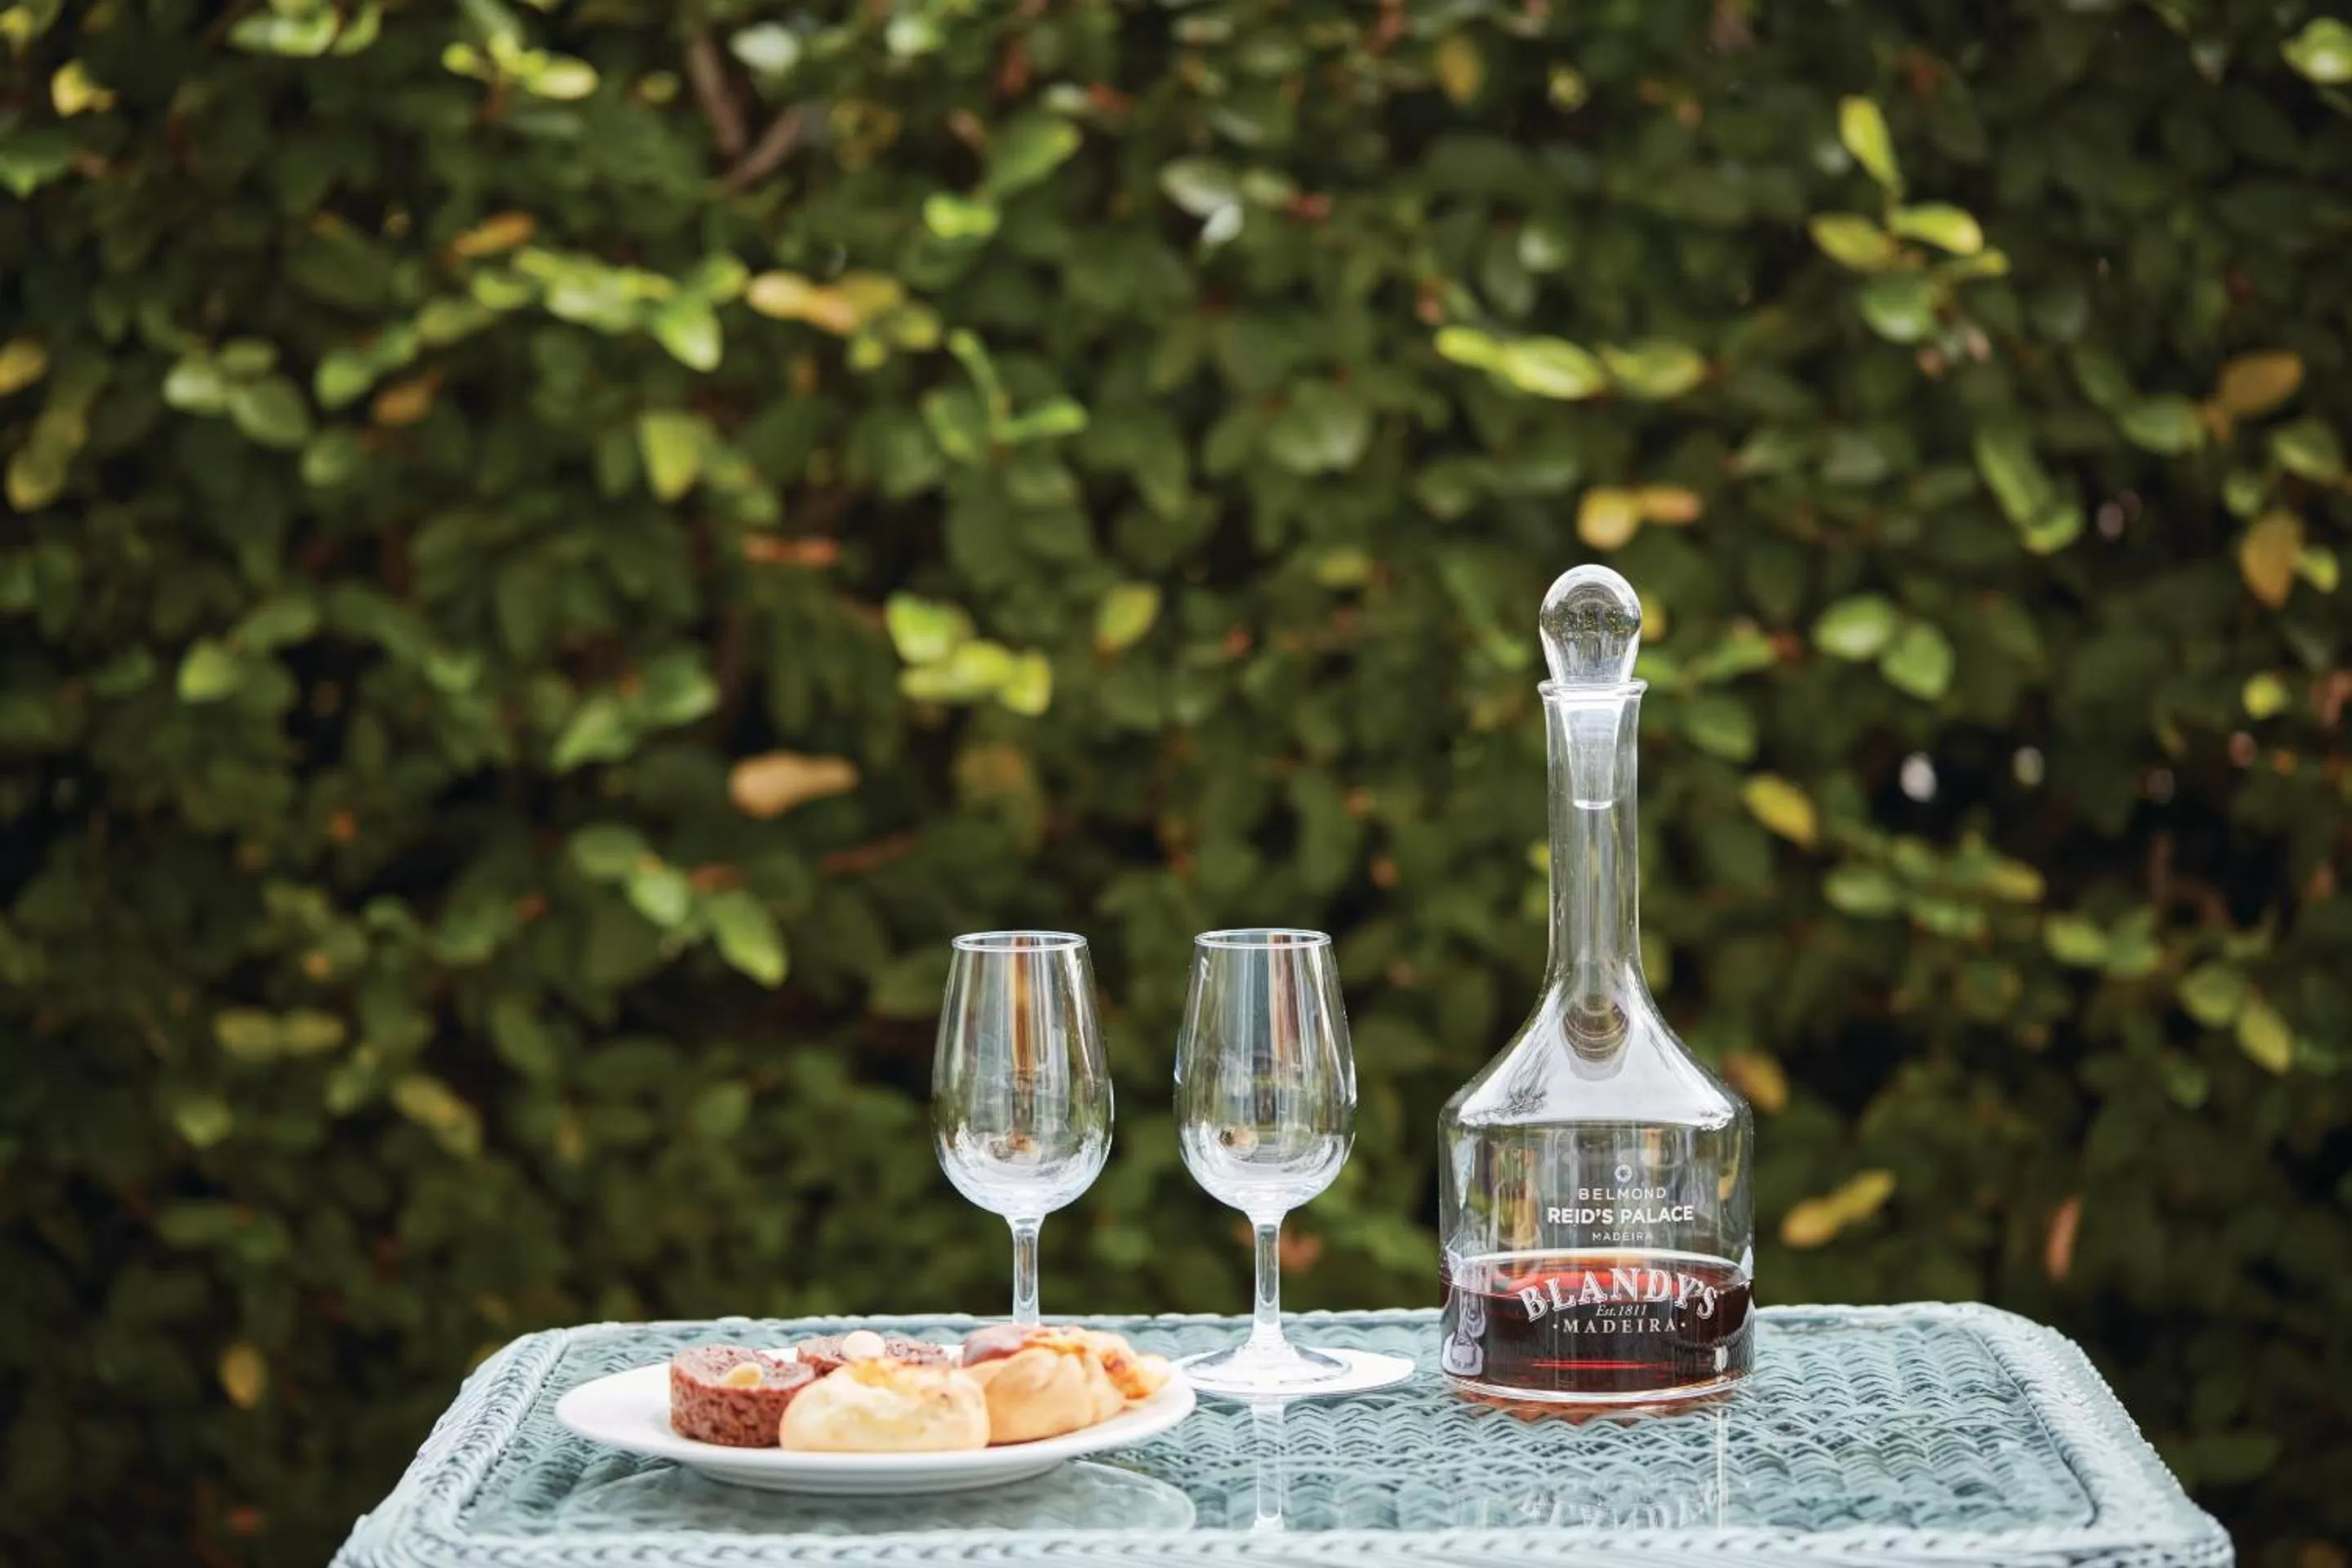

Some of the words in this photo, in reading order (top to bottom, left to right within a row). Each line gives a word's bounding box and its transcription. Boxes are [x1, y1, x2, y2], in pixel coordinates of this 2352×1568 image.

[1578, 1187, 1667, 1201] BELMOND
[1548, 1206, 1614, 1225] REID'S
[1620, 1205, 1695, 1223] PALACE
[1592, 1232, 1654, 1242] MADEIRA
[1518, 1267, 1718, 1323] BLANDY'S
